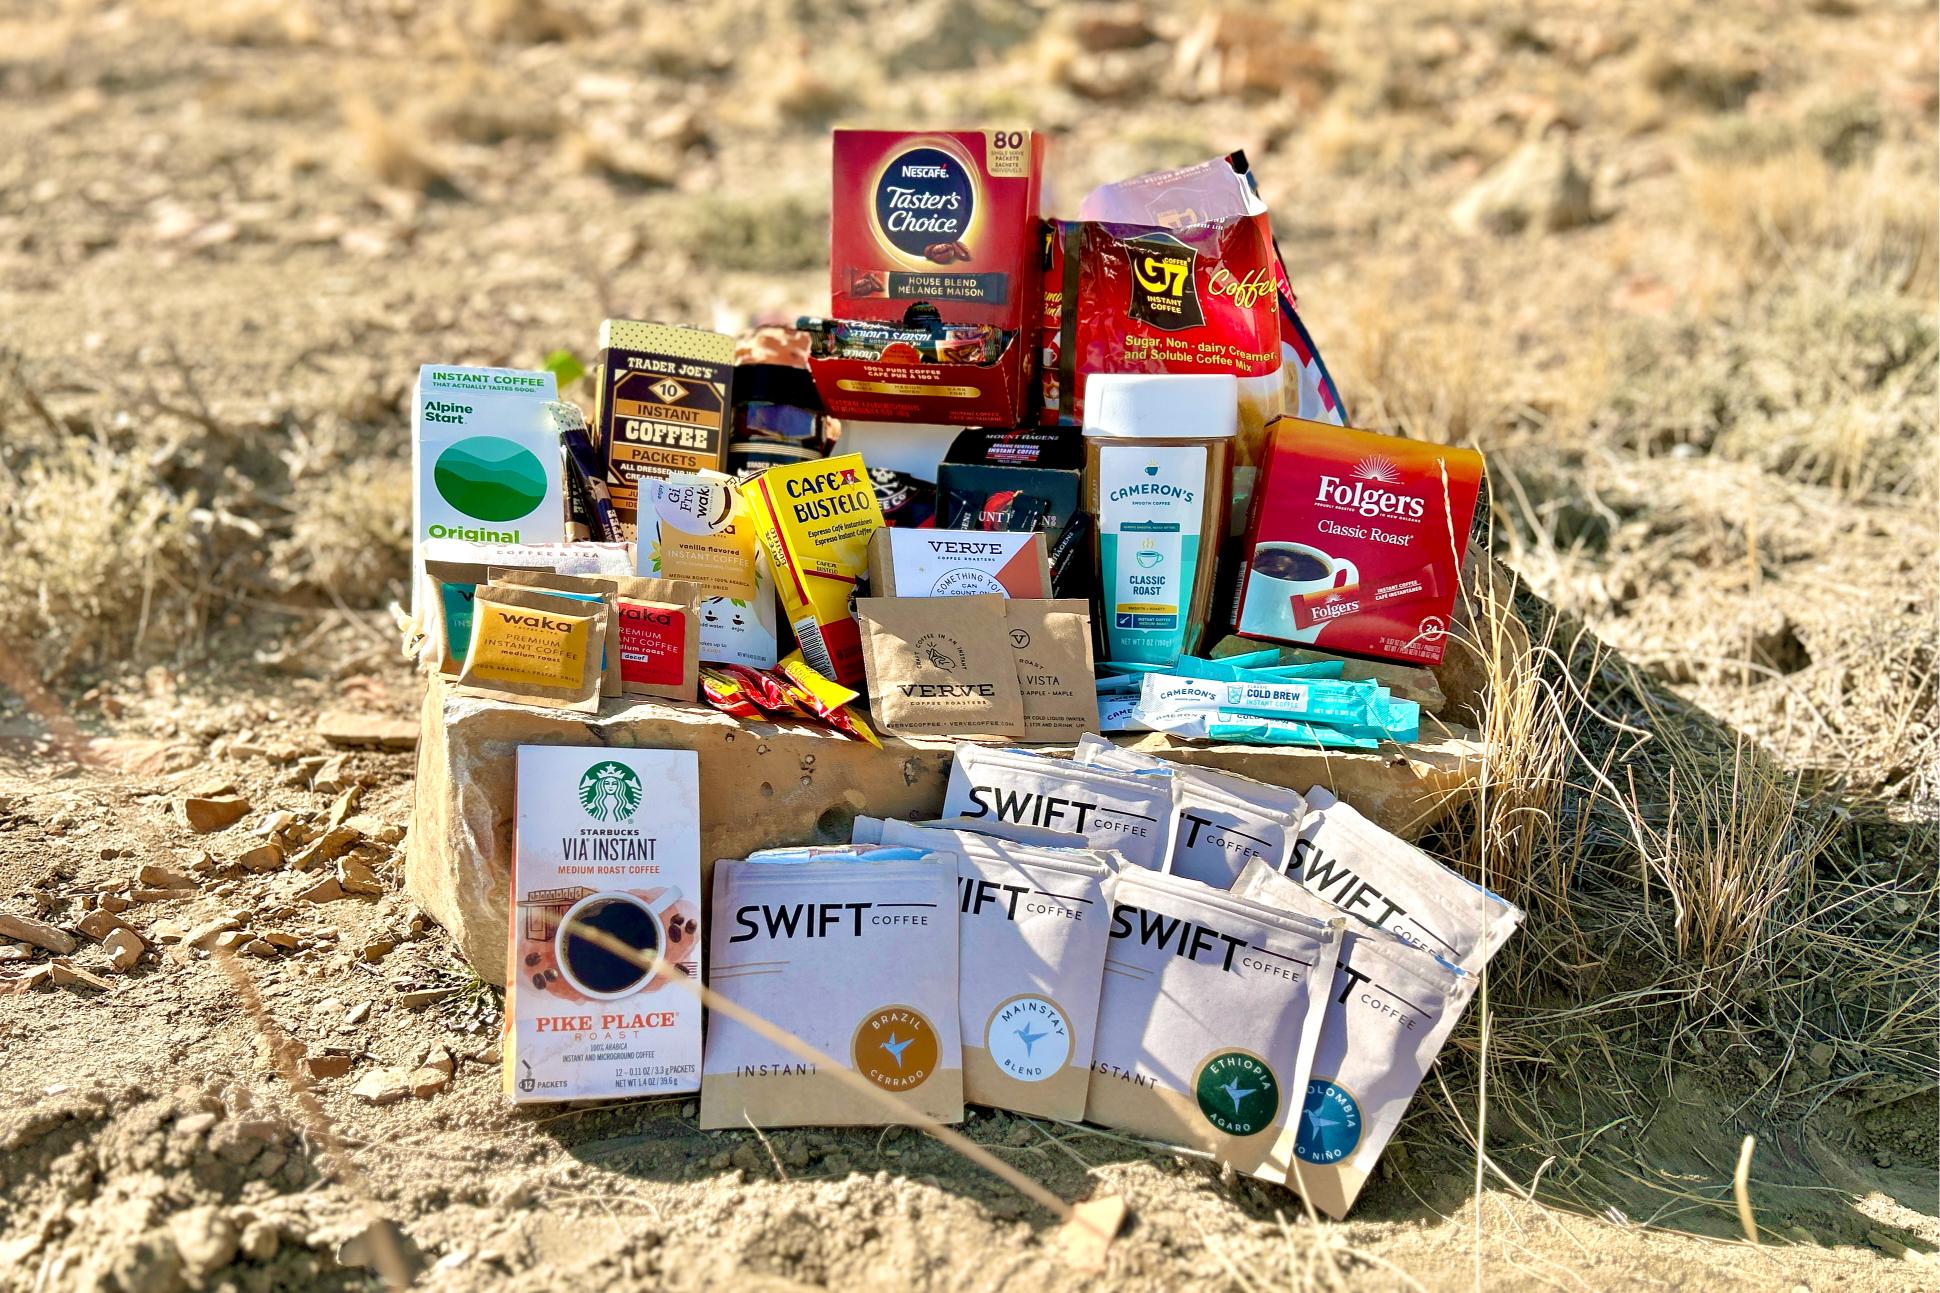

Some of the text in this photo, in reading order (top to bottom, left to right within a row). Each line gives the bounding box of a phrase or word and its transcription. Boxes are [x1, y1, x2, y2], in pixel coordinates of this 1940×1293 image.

[994, 131, 1023, 149] 80
[887, 186, 961, 210] Taster's
[887, 211, 956, 233] Choice
[1163, 257, 1188, 267] COFFEE
[908, 277, 977, 287] HOUSE BLEND
[1134, 257, 1189, 297] G7
[898, 283, 984, 297] MÉLANGE MAISON
[1147, 295, 1182, 307] INSTANT
[1151, 303, 1182, 314] COFFEE
[1125, 335, 1163, 349] Sugar,
[1166, 338, 1188, 349] Non
[1198, 341, 1226, 355] dairy
[627, 357, 713, 379] TRADER JOE'S
[1124, 350, 1253, 373] and Soluble Coffee Mix
[432, 372, 545, 387] INSTANT COFFEE
[452, 382, 486, 390] ACTUALLY
[659, 382, 678, 397] 10
[424, 400, 473, 414] Alpine
[637, 404, 700, 422] INSTANT
[425, 411, 464, 424] Start
[625, 420, 708, 449] COFFEE
[631, 449, 697, 467] PACKETS
[620, 463, 672, 475] ALL DRESSED
[1110, 483, 1194, 503] CAMERON'S
[1316, 475, 1425, 518] Folgers
[793, 491, 870, 523] BUSTELO
[428, 524, 520, 544] Original
[808, 528, 831, 538] Espresso
[815, 528, 872, 546] Espresso Instant Coffee
[1318, 519, 1410, 546] Classic Roast
[679, 543, 740, 556] vanilla flavored
[928, 541, 1002, 554] VERVE
[668, 549, 750, 566] INSTANT COFFEE
[937, 572, 983, 595] SOMETHING
[1129, 575, 1166, 585] CLASSIC
[1377, 580, 1418, 593] INSTANT COFFEE
[1133, 586, 1162, 596] ROAST
[1311, 600, 1359, 618] Folgers
[498, 613, 572, 633] waka
[1425, 624, 1438, 632] 24
[506, 634, 560, 647] PREMIUM
[619, 627, 661, 639] REMIUM
[485, 639, 577, 660] INSTANT COFFEE
[640, 639, 678, 654] COFFEE
[1121, 638, 1131, 646] NET
[1132, 638, 1140, 646] WT
[501, 650, 535, 658] medium
[642, 647, 664, 655] roast
[916, 633, 935, 648] COFFEE
[957, 647, 967, 670] INSTANT
[1019, 659, 1044, 669] ROAST
[1027, 675, 1060, 685] VISTA
[897, 684, 995, 697] VERVE
[1160, 688, 1216, 700] CAMERON'S
[1247, 689, 1300, 700] COLD BREW
[960, 786, 1097, 834] SWIFT
[1094, 819, 1147, 838] COFFEE
[580, 828, 639, 836] STARBUCKS
[562, 838, 656, 860] VIA INSTANT
[1206, 835, 1260, 857] COFFEE
[558, 865, 660, 874] MEDIUM ROAST COFFEE
[1288, 838, 1407, 928] SWIFT
[958, 876, 1083, 921] IFT COFFEE
[729, 902, 929, 943] SWIFT COFFEE
[1110, 905, 1300, 982] SWIFT COFFEE
[1001, 1002, 1064, 1036] MAINSTAY
[1361, 994, 1417, 1031] COFFEE
[536, 1012, 675, 1032] PIKE PLACE
[871, 1012, 921, 1030] BRAZIL
[575, 1030, 640, 1041] ROAST
[590, 1042, 627, 1052] 100% ARABICA
[563, 1050, 655, 1062] INSTANT AND MICROGROUND COFFEE
[615, 1068, 622, 1077] 12
[670, 1065, 695, 1074] PACKETS
[736, 1063, 817, 1078] INSTANT
[1004, 1059, 1042, 1075] BLEND
[1210, 1058, 1271, 1090] ETHIOPIA
[524, 1081, 568, 1089] 12 PACKETS
[615, 1079, 627, 1088] NET
[628, 1079, 637, 1087] WT
[870, 1069, 924, 1086] CERRADO
[1307, 1085, 1356, 1128] OLOMBIA
[1210, 1113, 1250, 1131] AGARO
[1312, 1149, 1342, 1160] NIÑO
